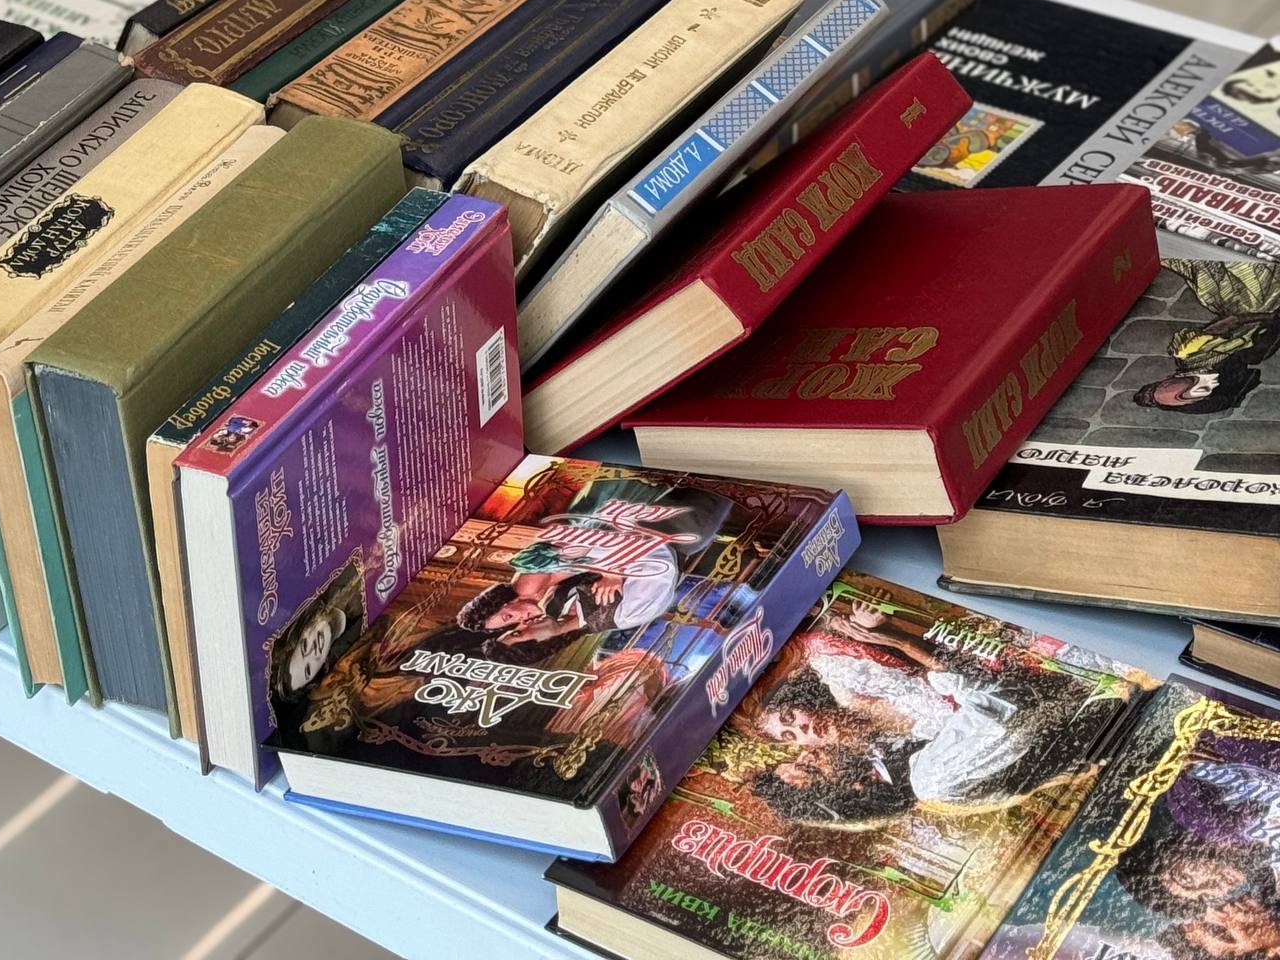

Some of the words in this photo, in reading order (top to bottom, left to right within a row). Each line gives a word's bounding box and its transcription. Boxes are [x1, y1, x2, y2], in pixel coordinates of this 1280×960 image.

[649, 35, 686, 70] ВИКОНТ
[936, 36, 1008, 65] СВОИХ
[947, 27, 1046, 62] ЖЕНЩИН
[630, 68, 647, 83] ДЕ
[578, 78, 632, 130] БРАЖЕЛОН
[1107, 54, 1216, 146] АЛЕКСЕЙ
[72, 90, 156, 157] ЗАПИСКИ
[59, 156, 83, 169] О
[644, 152, 690, 200] ДЮМА
[796, 142, 884, 232] ЖОРЖ
[41, 202, 90, 240] КОНАН
[49, 221, 90, 258] АРТУР
[1179, 214, 1264, 244] Сергей
[10, 241, 44, 267] ДОЙЛ
[730, 208, 816, 292] САНД
[299, 279, 412, 367] Очаровательный
[227, 339, 282, 385] Гюстав
[1021, 298, 1084, 401] ЖОРЖ
[264, 362, 310, 396] повеса
[173, 385, 231, 430] Флобер
[367, 378, 387, 440] повеса
[962, 373, 1023, 470] САНД
[1016, 448, 1136, 468] МАРГО
[374, 446, 401, 603] Очаровательный
[596, 499, 694, 521] леди
[400, 648, 599, 709] БЕВЕРЛИ
[649, 880, 720, 921] КВИК
[670, 820, 890, 949] Сюрприз
